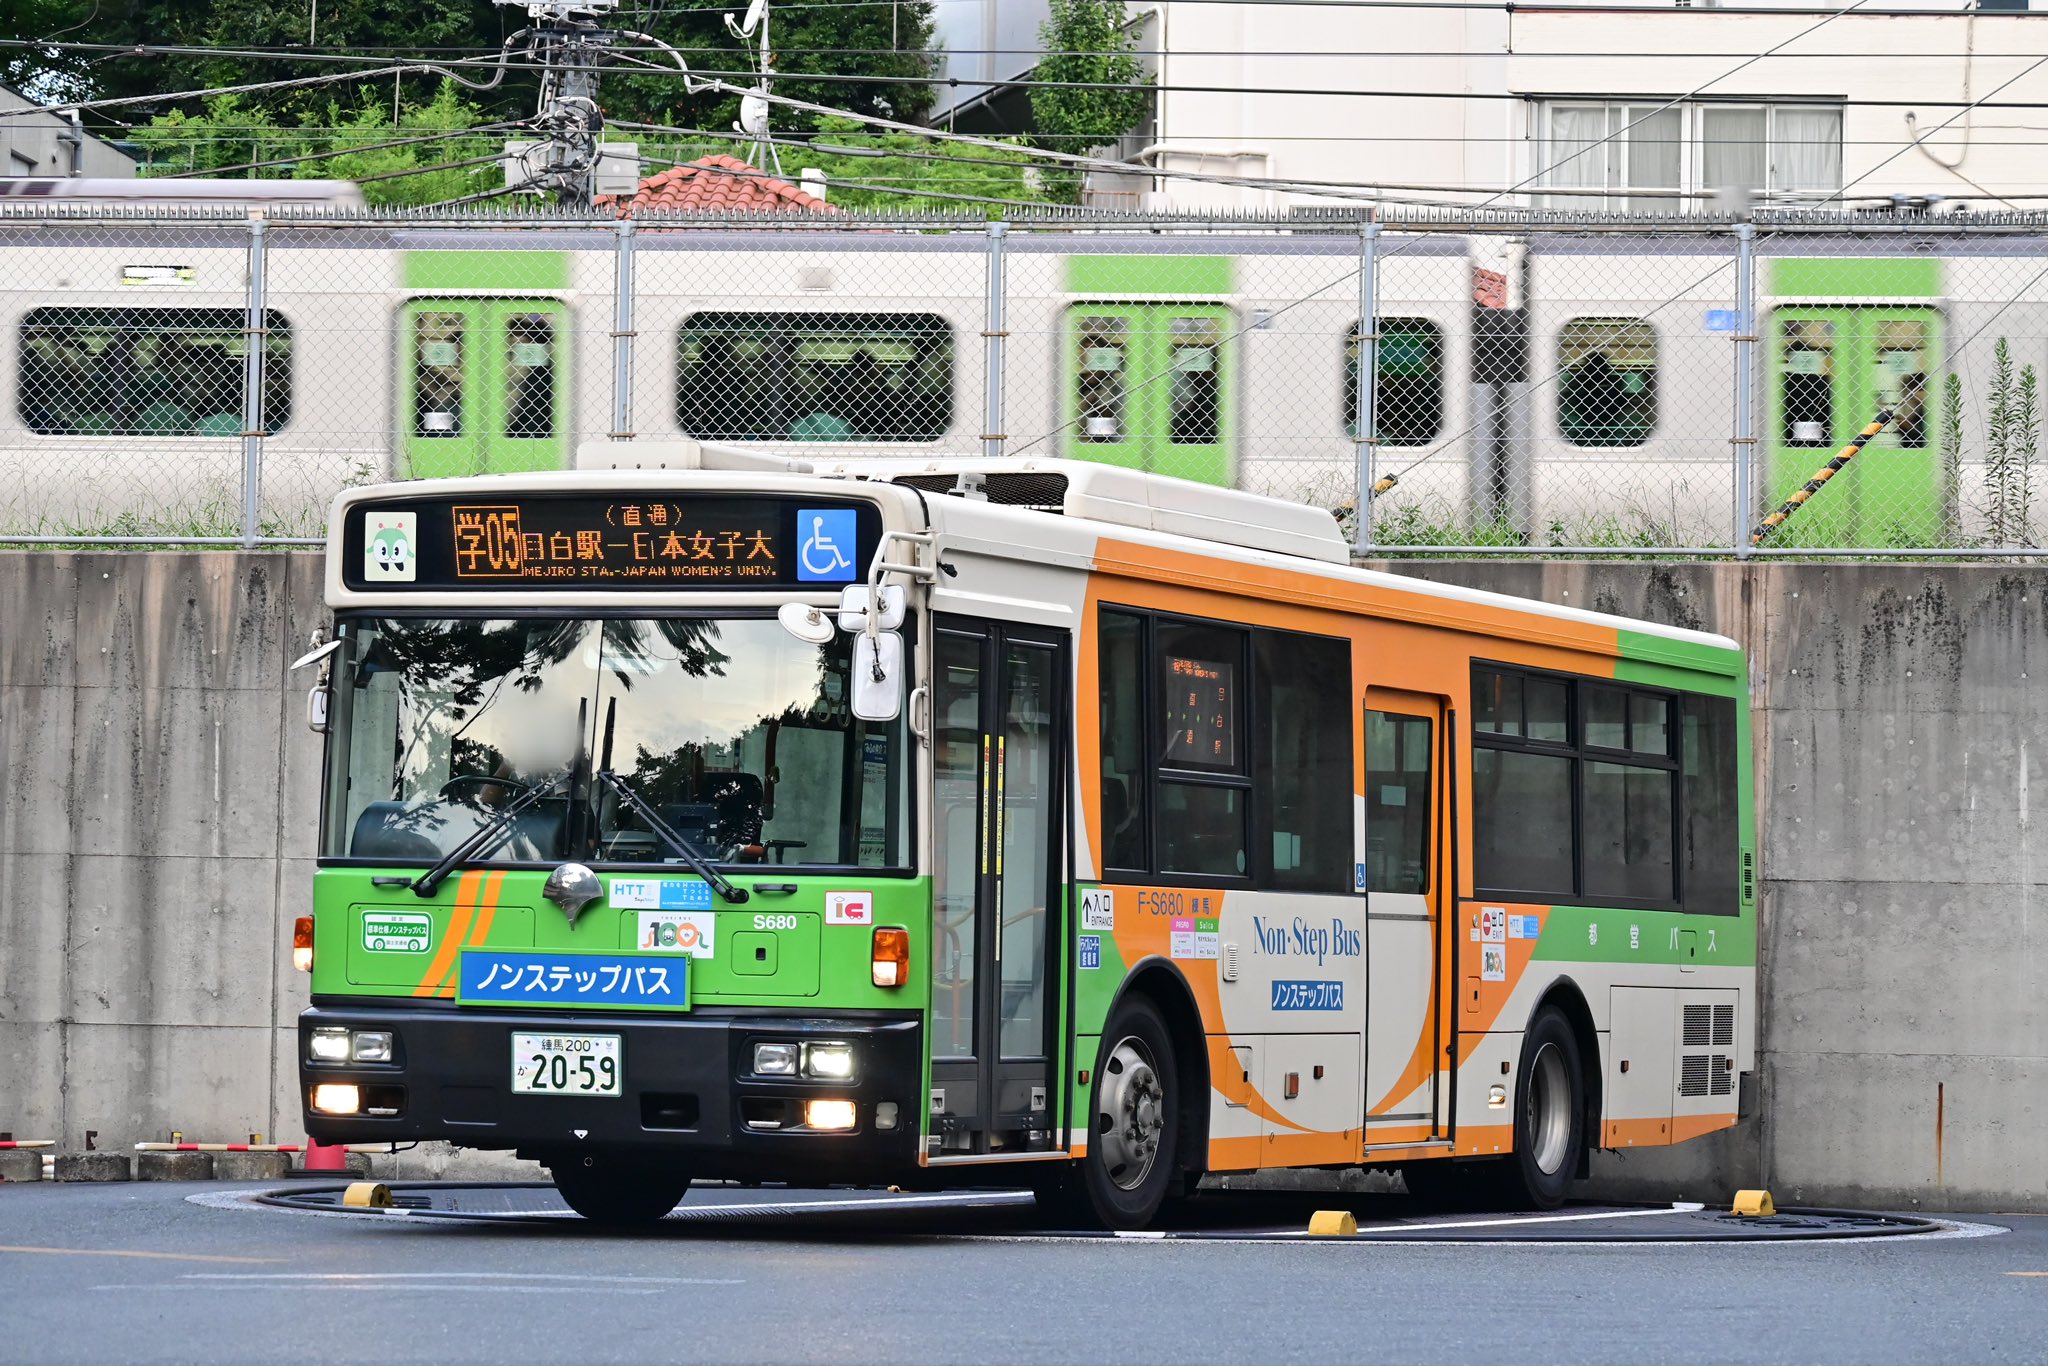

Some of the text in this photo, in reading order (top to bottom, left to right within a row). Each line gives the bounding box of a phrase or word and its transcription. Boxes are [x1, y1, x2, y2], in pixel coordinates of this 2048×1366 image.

[456, 512, 520, 570] 学05
[524, 566, 576, 577] MEJIRO
[671, 565, 732, 576] WOMEN'S
[737, 565, 777, 576] UNIV.
[614, 884, 645, 895] HTT
[1094, 894, 1111, 912] 入口
[1138, 891, 1184, 916] F-S680
[753, 914, 797, 930] S680
[1091, 915, 1113, 927] ENTRANCE
[1332, 917, 1361, 957] Bus
[476, 963, 671, 995] ノンステップバス
[1272, 983, 1343, 1008] ノンステップバス
[517, 1054, 616, 1091] か 20-59
